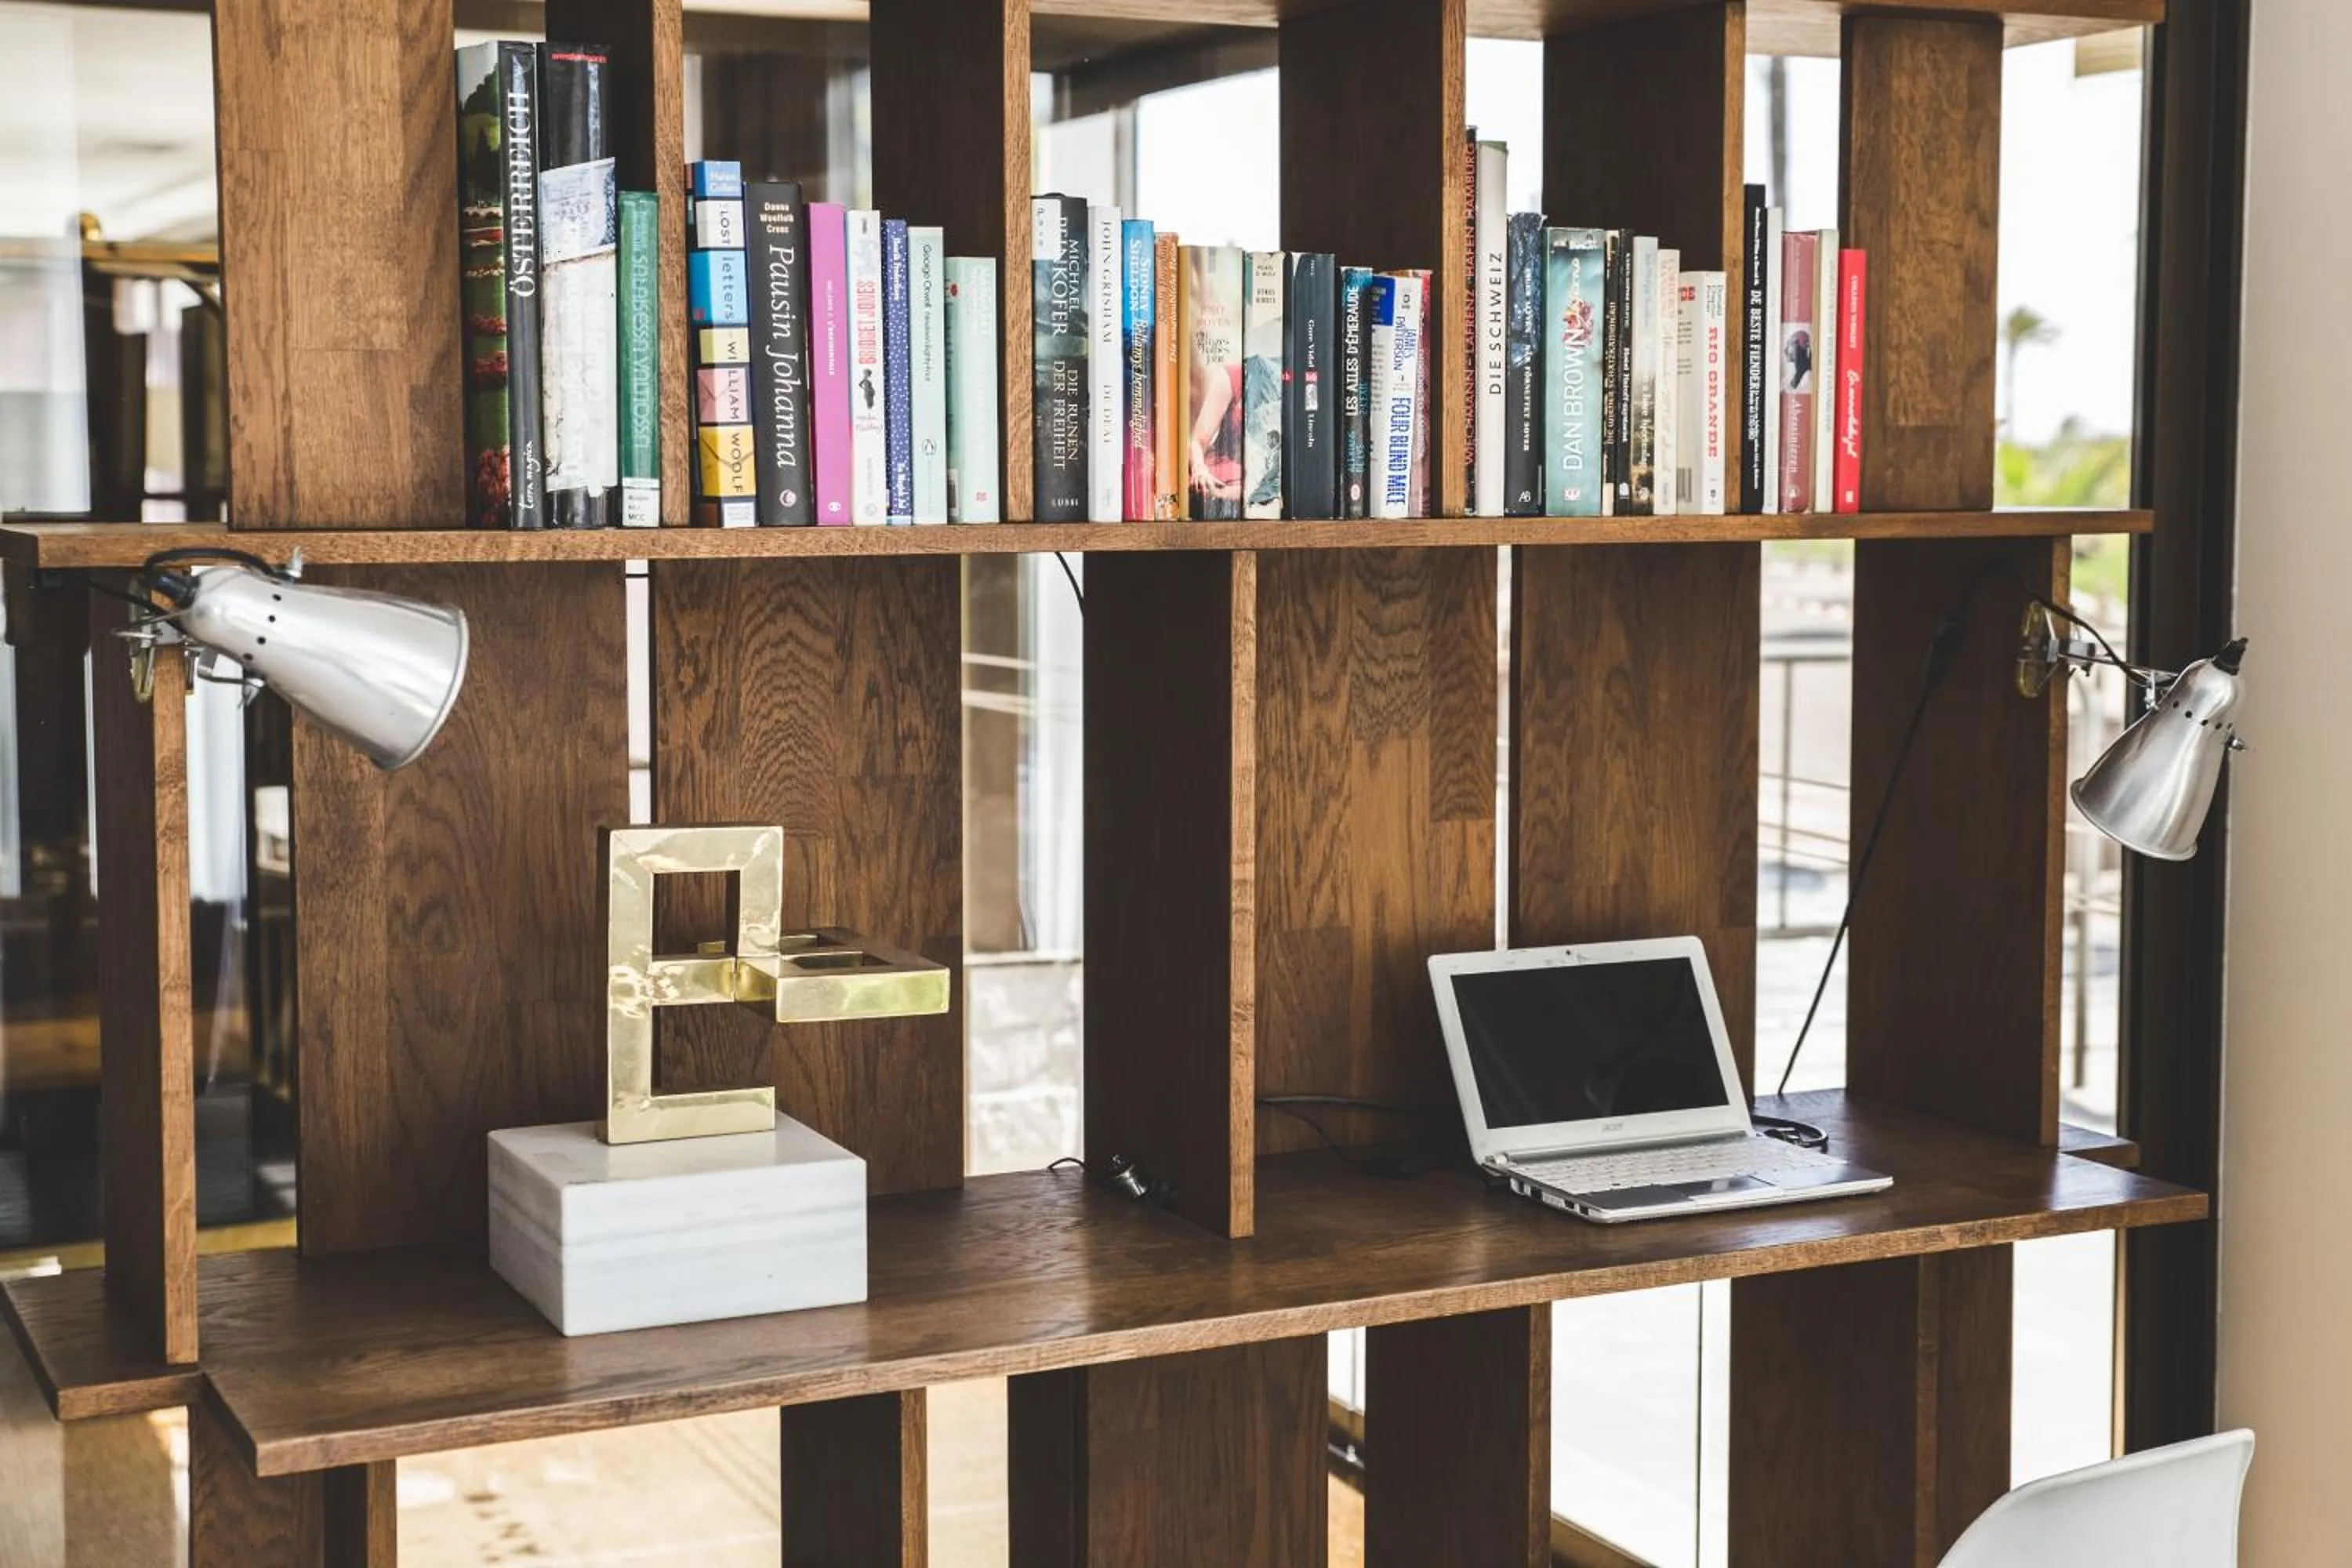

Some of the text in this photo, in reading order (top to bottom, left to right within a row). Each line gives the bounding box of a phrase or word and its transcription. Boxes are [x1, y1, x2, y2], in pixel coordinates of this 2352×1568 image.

[508, 89, 535, 297] ÖSTERREICH
[1465, 143, 1475, 220] HAMBURG
[720, 211, 731, 245] LOST
[1102, 220, 1112, 263] JOHN
[1465, 226, 1475, 277] HAFEN
[722, 256, 736, 320] letters
[1068, 239, 1080, 313] MICHAEL
[1102, 269, 1113, 343] GRISHAM
[1129, 238, 1142, 312] SHELDON
[1139, 257, 1151, 312] SIDNEY
[1750, 289, 1762, 305] DE
[858, 320, 877, 365] BRIDGET
[1307, 319, 1316, 368] Gore Vidal
[1345, 285, 1359, 416] LES AILES D'ÉMERAUDE
[1392, 316, 1408, 371] PATTERSON
[1403, 328, 1417, 358] JAMES
[1465, 289, 1475, 354] LAFRENZ
[1488, 252, 1502, 395] DIE SCHWEIZ
[1750, 308, 1762, 341] BESTE
[764, 245, 802, 468] Pausin Johanna
[1053, 361, 1066, 471] DER FREIHEIT
[1067, 370, 1079, 461] DIE RUNEN
[1563, 328, 1584, 470] DAN BROWN
[1708, 326, 1719, 458] RIO GRANDE
[1307, 413, 1316, 448] Lincoln
[1385, 397, 1412, 506] FOUR BLIND MICE
[730, 433, 743, 494] WOOLF
